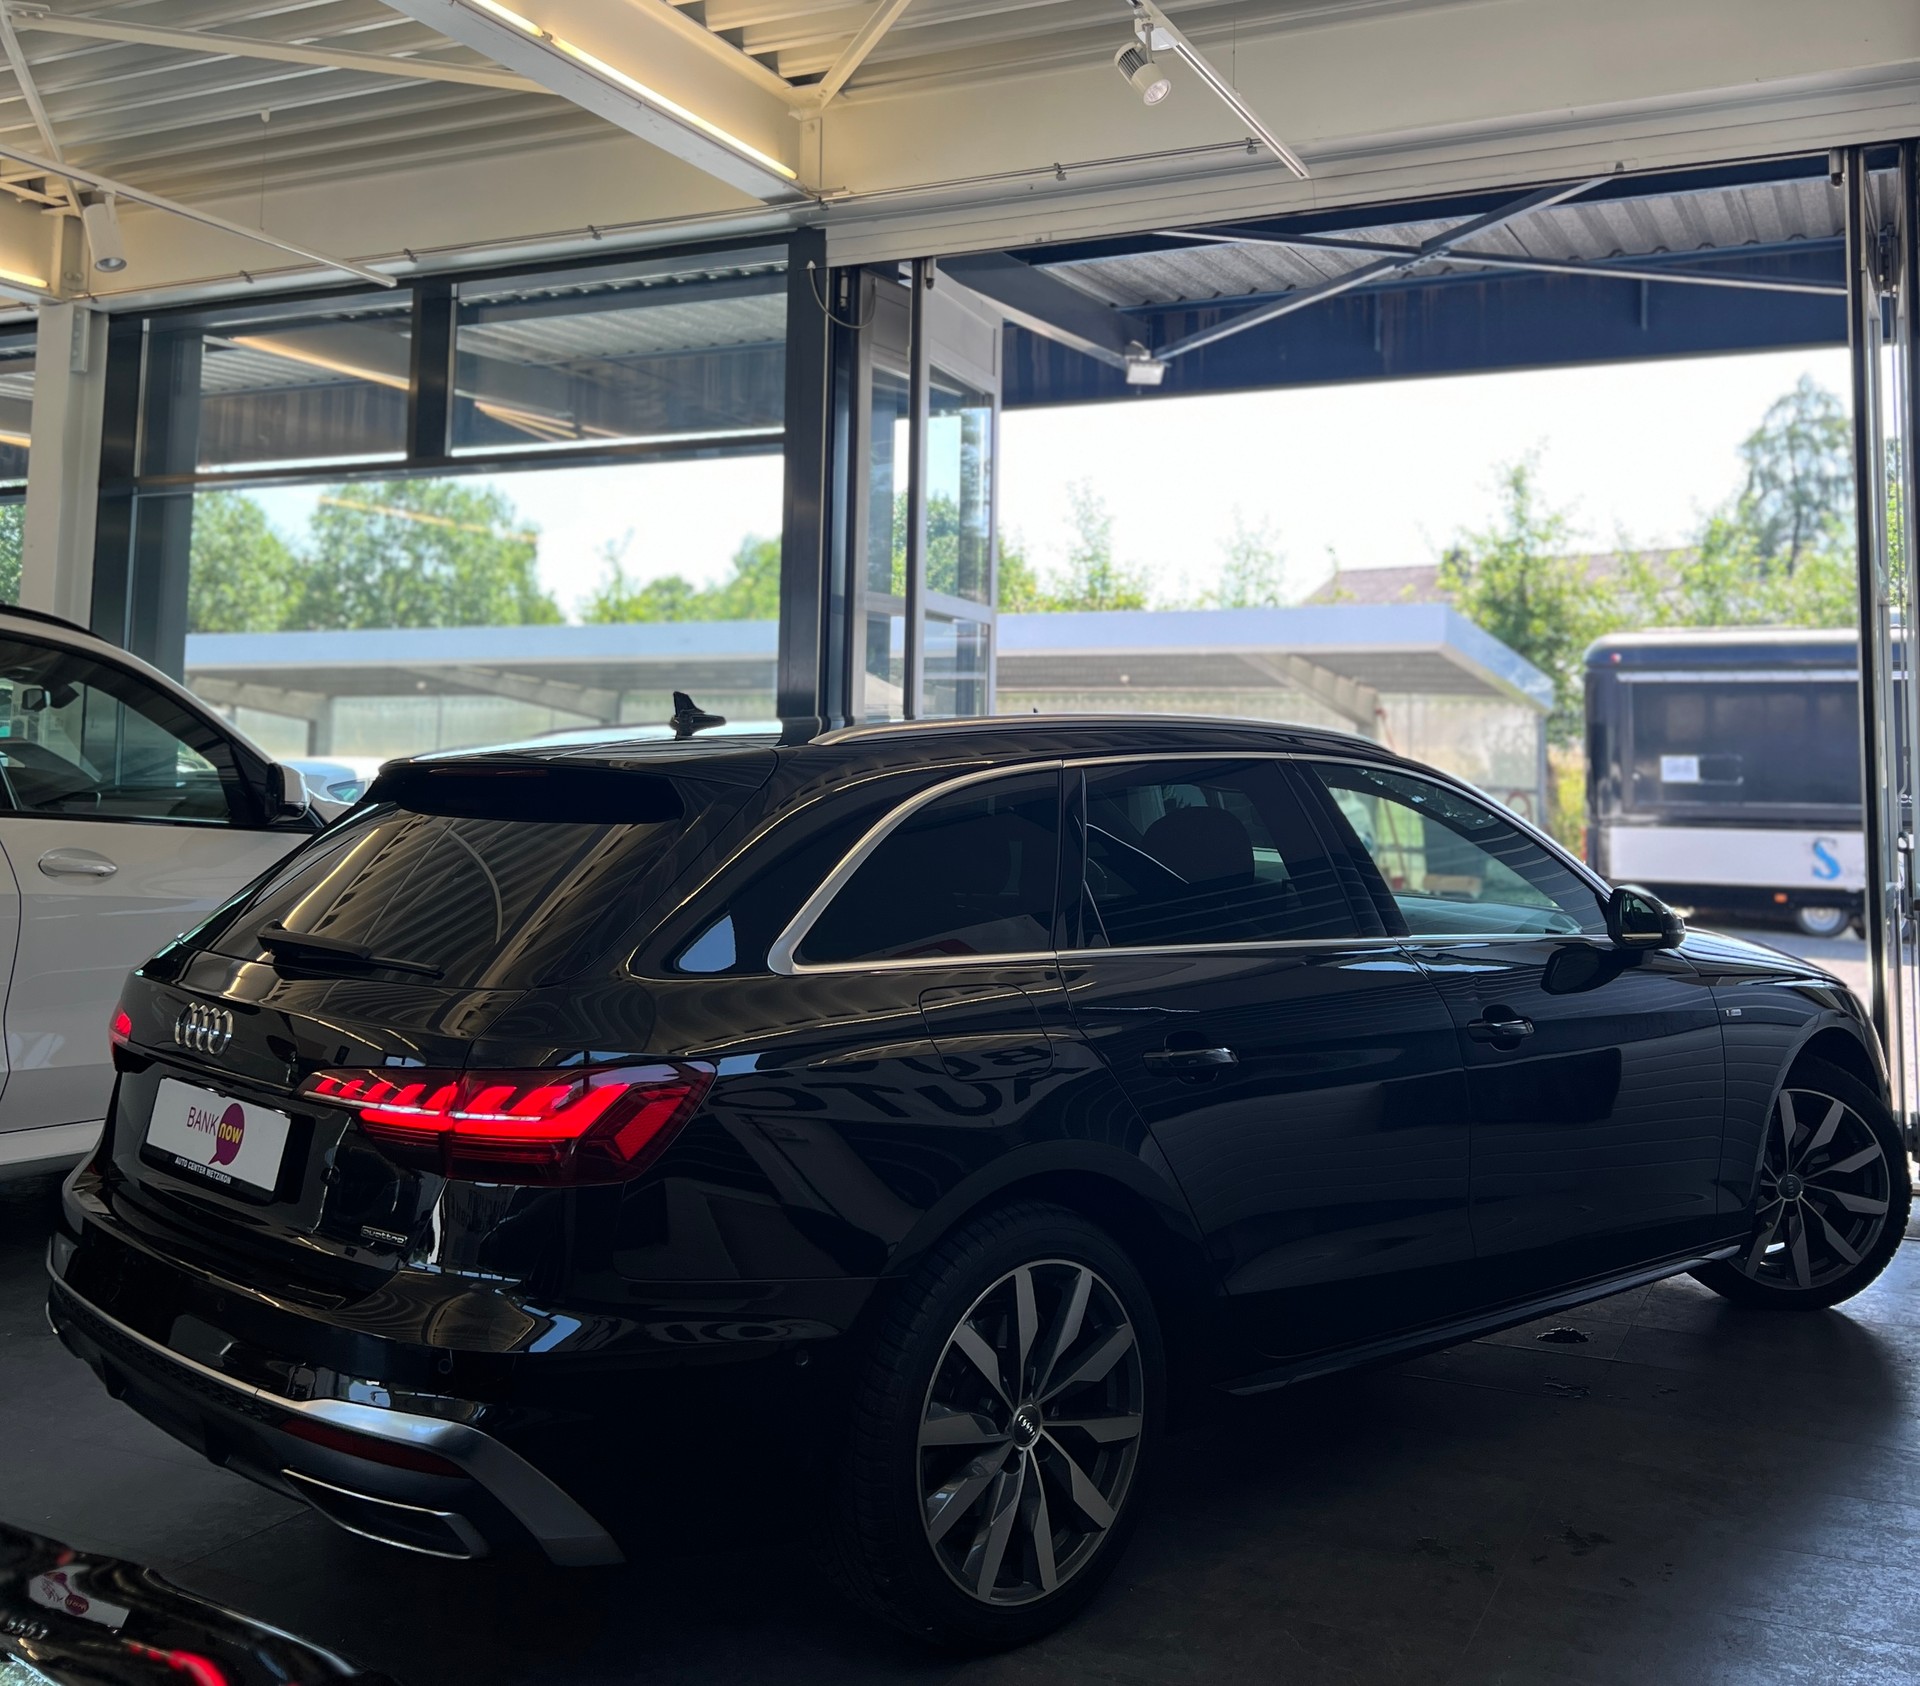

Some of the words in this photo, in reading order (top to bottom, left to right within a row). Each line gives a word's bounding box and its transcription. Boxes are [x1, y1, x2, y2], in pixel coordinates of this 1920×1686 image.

[187, 1106, 219, 1136] BANK
[218, 1123, 242, 1143] now
[174, 1156, 188, 1167] AUTO
[187, 1161, 206, 1174] CENTER
[362, 1228, 405, 1244] quattro
